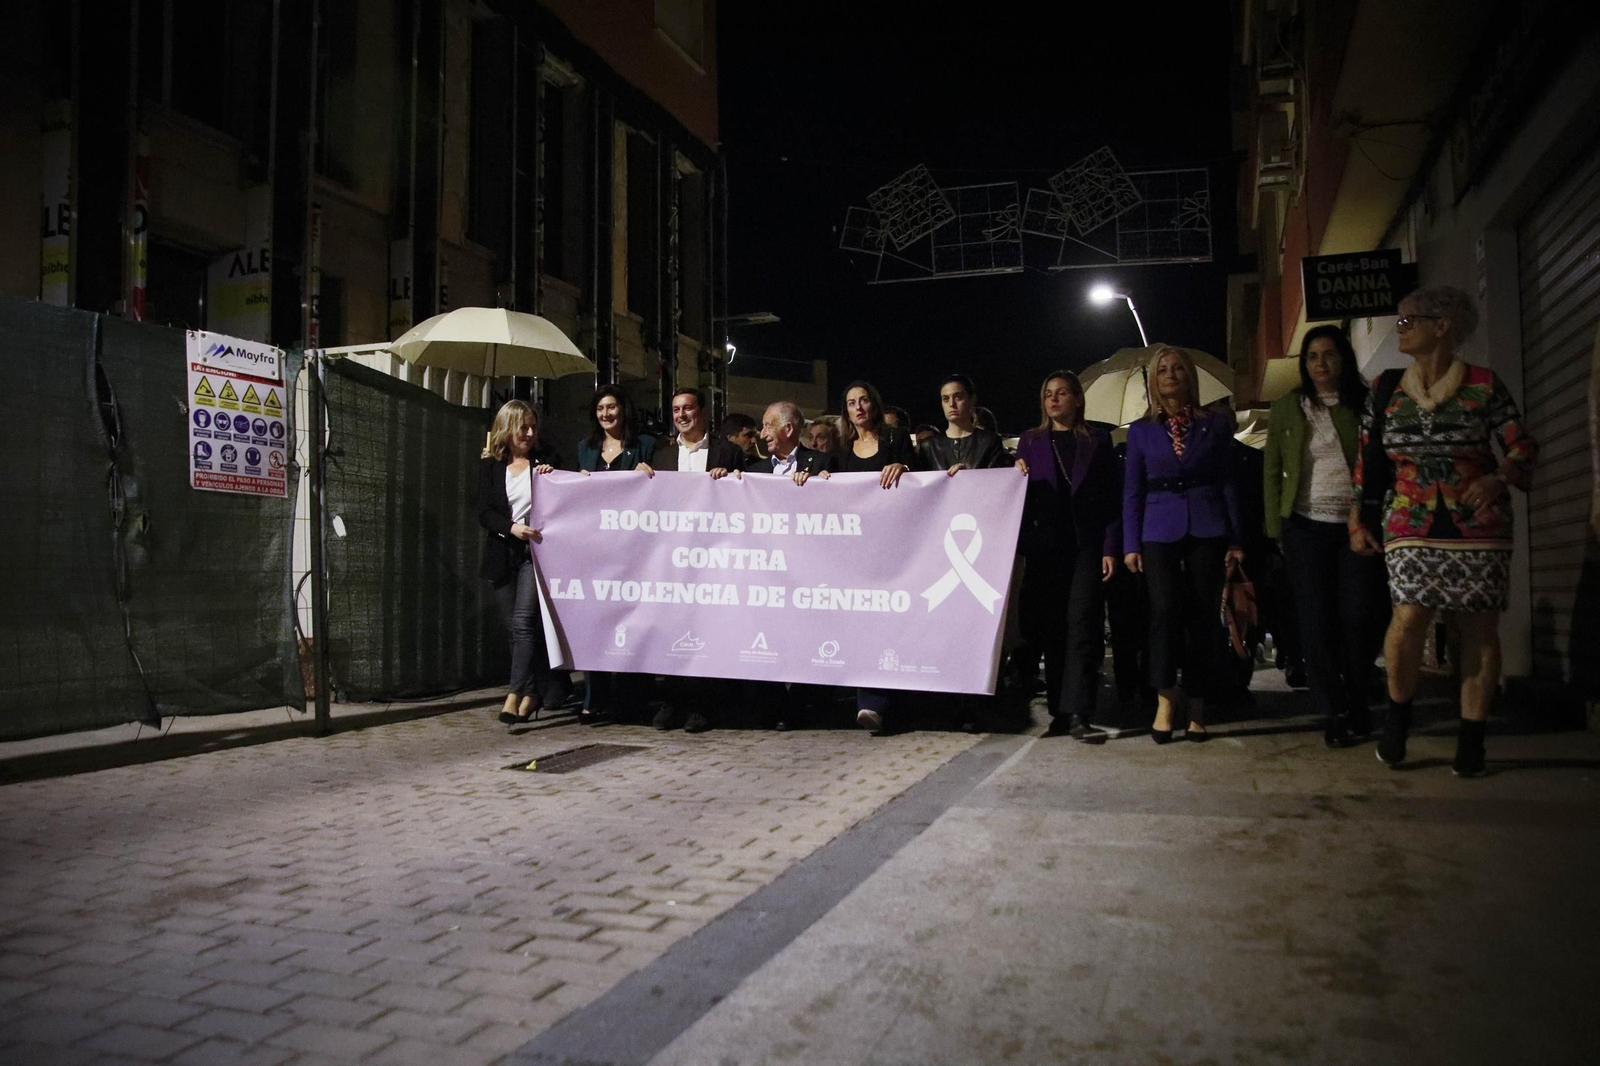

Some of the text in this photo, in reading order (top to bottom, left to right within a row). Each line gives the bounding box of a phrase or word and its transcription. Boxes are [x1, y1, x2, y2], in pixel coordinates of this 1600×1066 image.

[1317, 258, 1389, 274] Café-Bar
[1318, 273, 1391, 294] DANNA
[236, 348, 275, 364] Mayfra
[195, 472, 228, 481] PROHIBIDO
[257, 479, 284, 487] PERSONAS
[269, 487, 284, 495] OBRA
[599, 509, 863, 536] ROQUETAS DE MAR
[672, 547, 788, 571] CONTRA
[550, 578, 911, 613] LA VIOLENCIA DE GÉNERO
